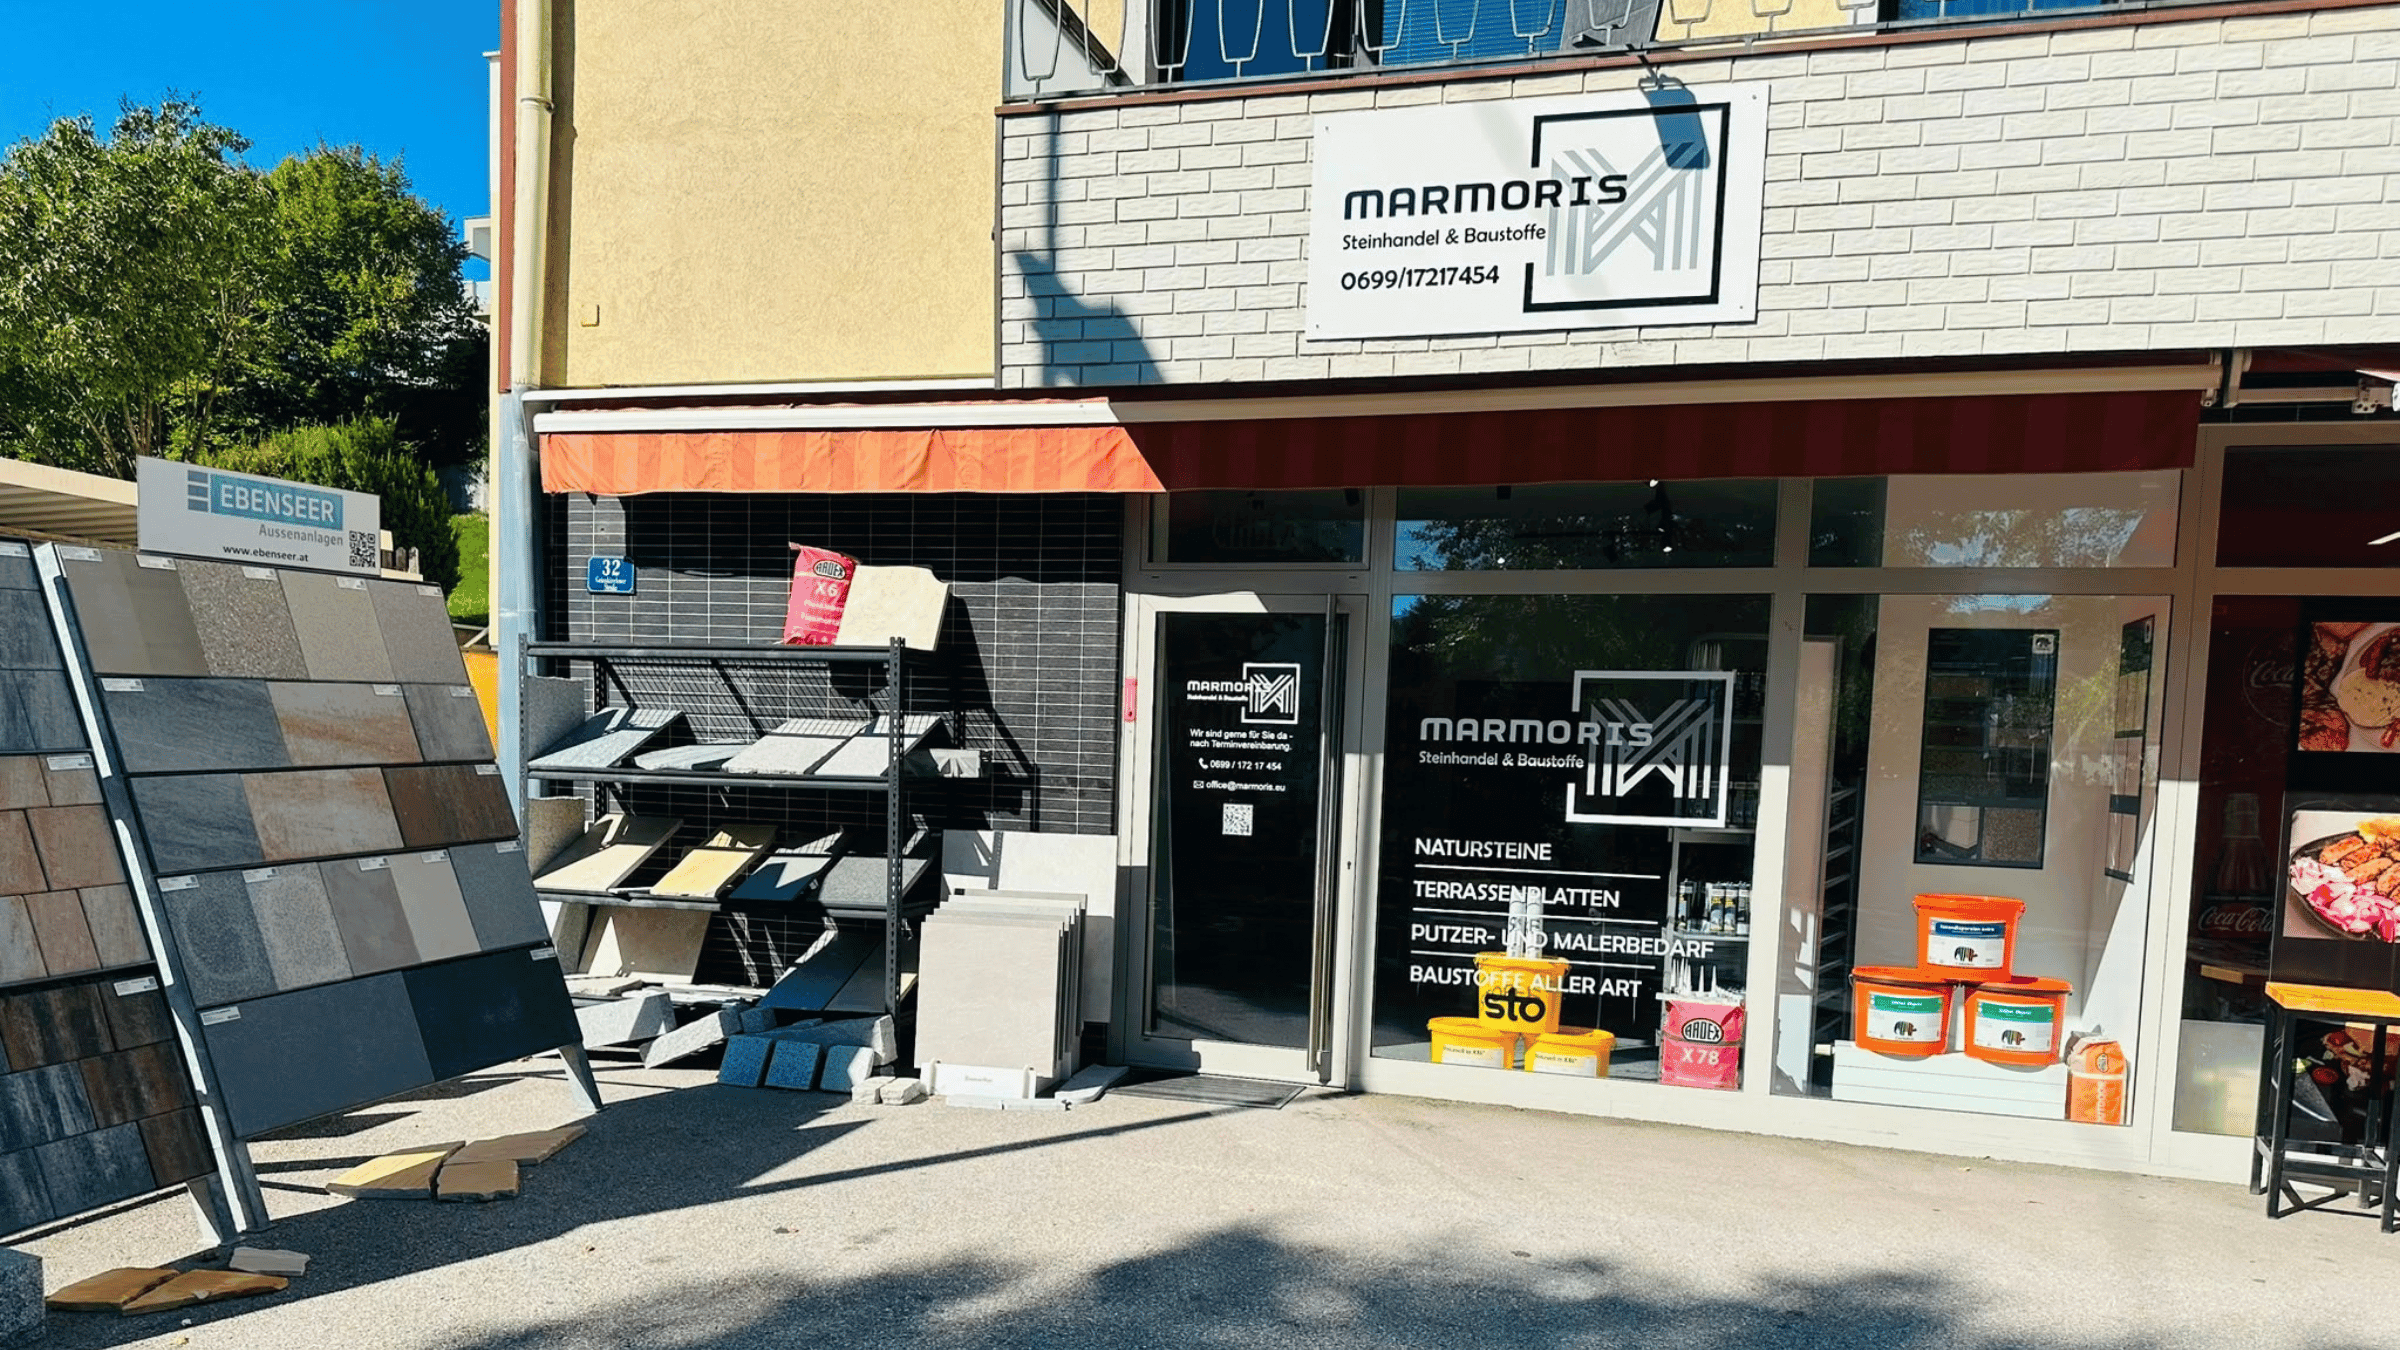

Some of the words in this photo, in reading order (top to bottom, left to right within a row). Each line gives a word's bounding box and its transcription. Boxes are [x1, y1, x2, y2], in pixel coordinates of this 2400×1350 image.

[1344, 173, 1628, 220] MARMORIS
[1342, 229, 1440, 250] Steinhandel
[1445, 228, 1459, 244] &
[1464, 223, 1546, 243] Baustoffe
[1341, 264, 1499, 291] 0699/17217454
[220, 484, 335, 523] EBENSEER
[259, 524, 343, 547] Aussenanlagen
[223, 545, 309, 563] www.ebenseer.at
[602, 559, 621, 576] 32
[1189, 739, 1210, 748] nach
[1190, 729, 1204, 737] Wir
[1205, 729, 1222, 738] sind
[1249, 730, 1260, 739] für
[1261, 730, 1275, 739] Sie
[1276, 731, 1288, 740] da
[1419, 717, 1654, 747] MARMORIS
[1209, 760, 1230, 769] 0699
[1237, 761, 1253, 770] 172
[1254, 761, 1265, 770] 17
[1266, 762, 1282, 771] 454
[1419, 750, 1499, 766] Steinhandel
[1502, 752, 1515, 767] &
[1517, 752, 1585, 769] Baustoffe
[1205, 780, 1286, 792] office@marmoris.eu
[1414, 838, 1552, 861] NATURSTEINE
[1413, 880, 1620, 908] TERRASSENPLATTEN
[1411, 923, 1495, 946] PUTZER-
[1501, 928, 1548, 948] UND
[1554, 930, 1715, 959] MALERBEDARF
[1409, 965, 1524, 990] BAUSTOFFE
[1531, 975, 1597, 995] ALLER
[1599, 977, 1642, 998] ART
[1484, 987, 1546, 1022] sto
[1685, 1021, 1720, 1040] ARDEX
